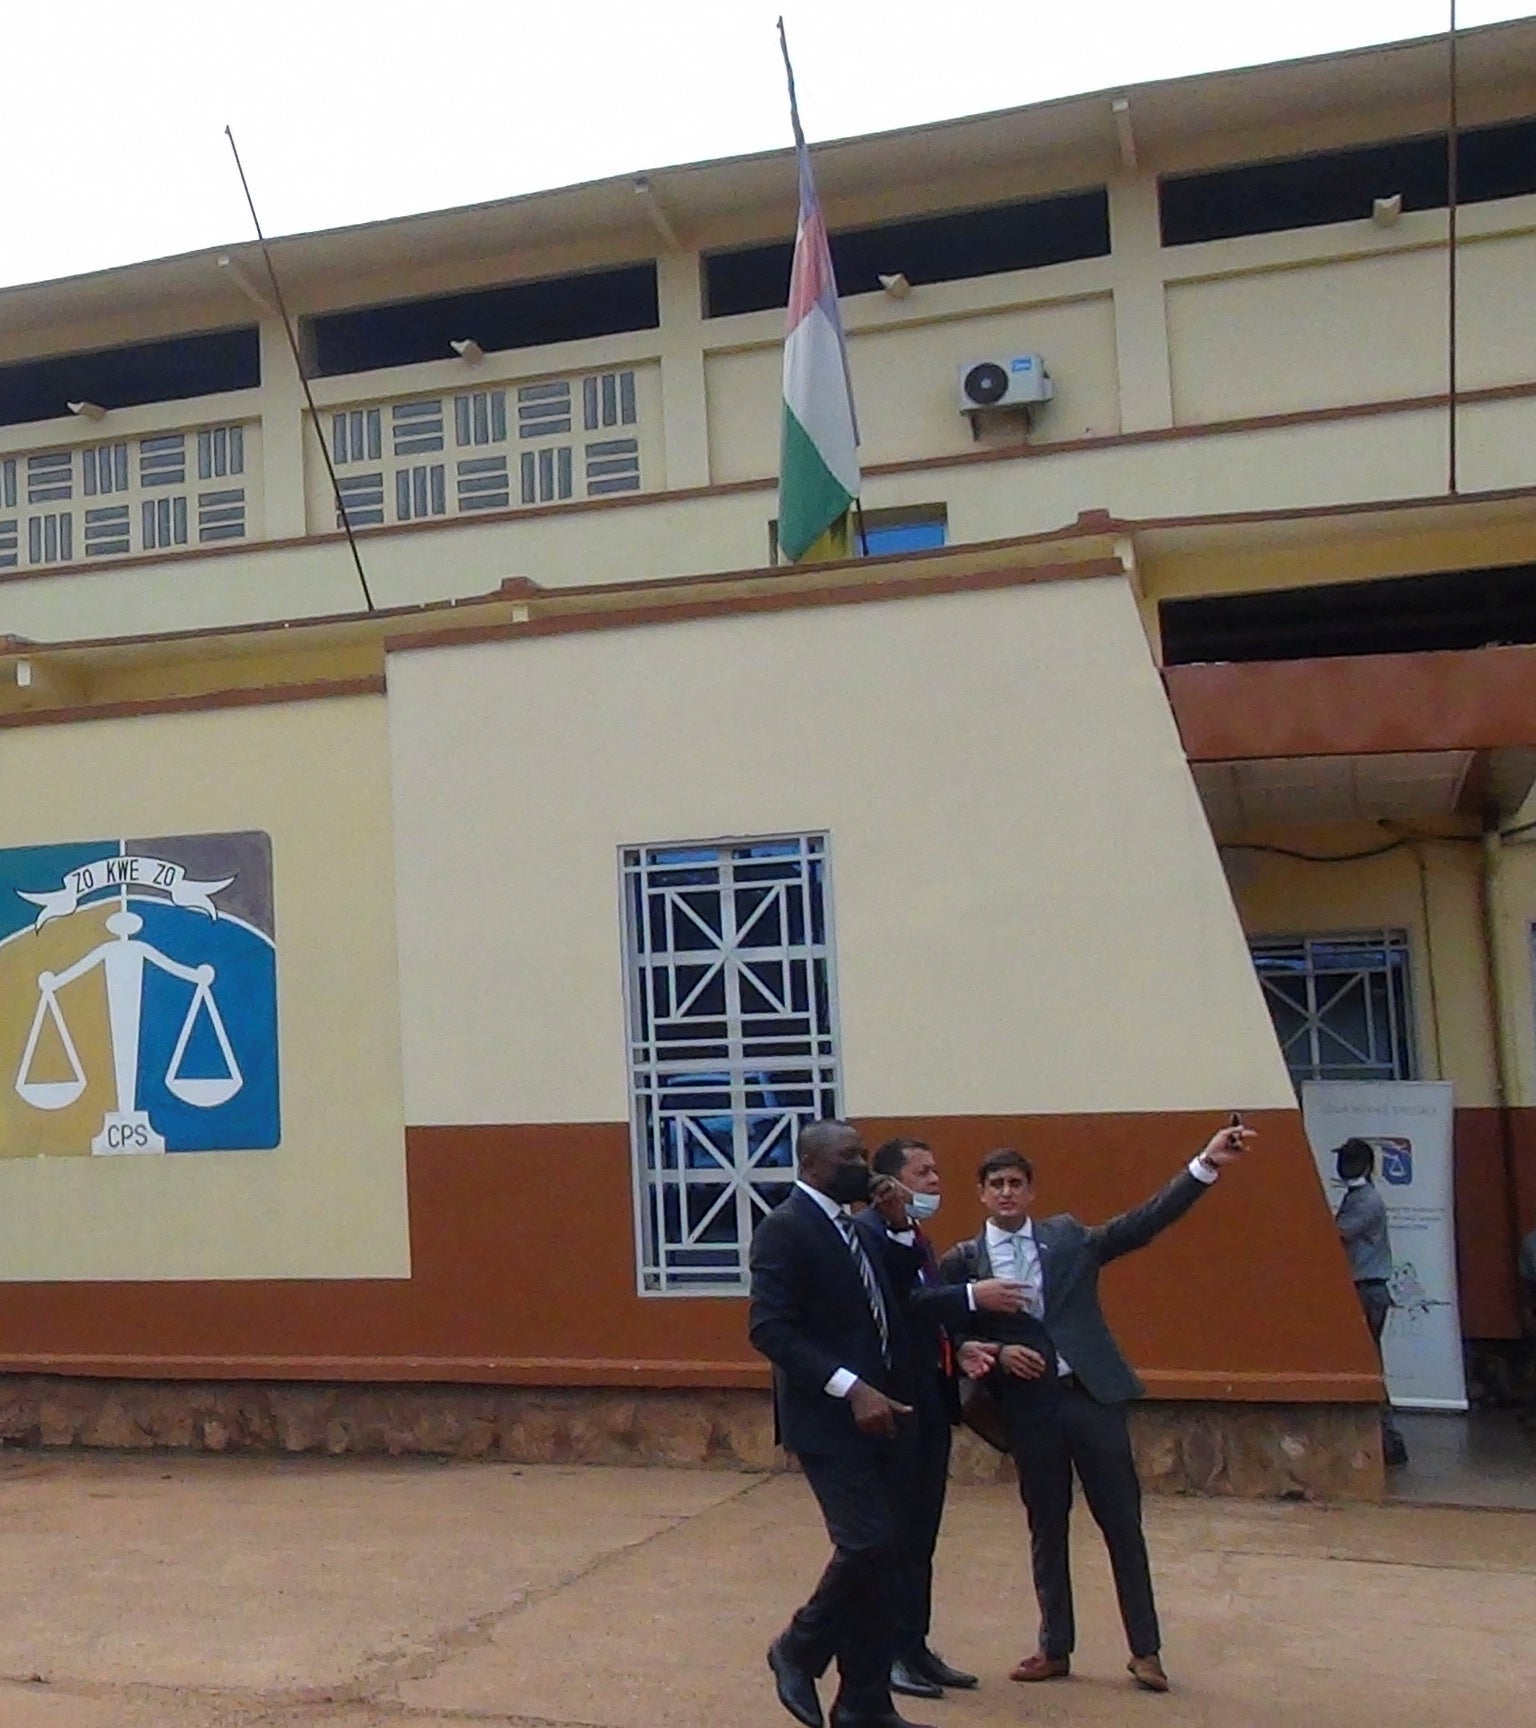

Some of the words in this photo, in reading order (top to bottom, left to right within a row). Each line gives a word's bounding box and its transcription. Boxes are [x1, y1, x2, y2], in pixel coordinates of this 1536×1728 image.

[72, 869, 94, 894] ZO
[106, 859, 139, 883] KWE
[152, 863, 176, 887] ZO
[108, 1124, 148, 1148] CPS
